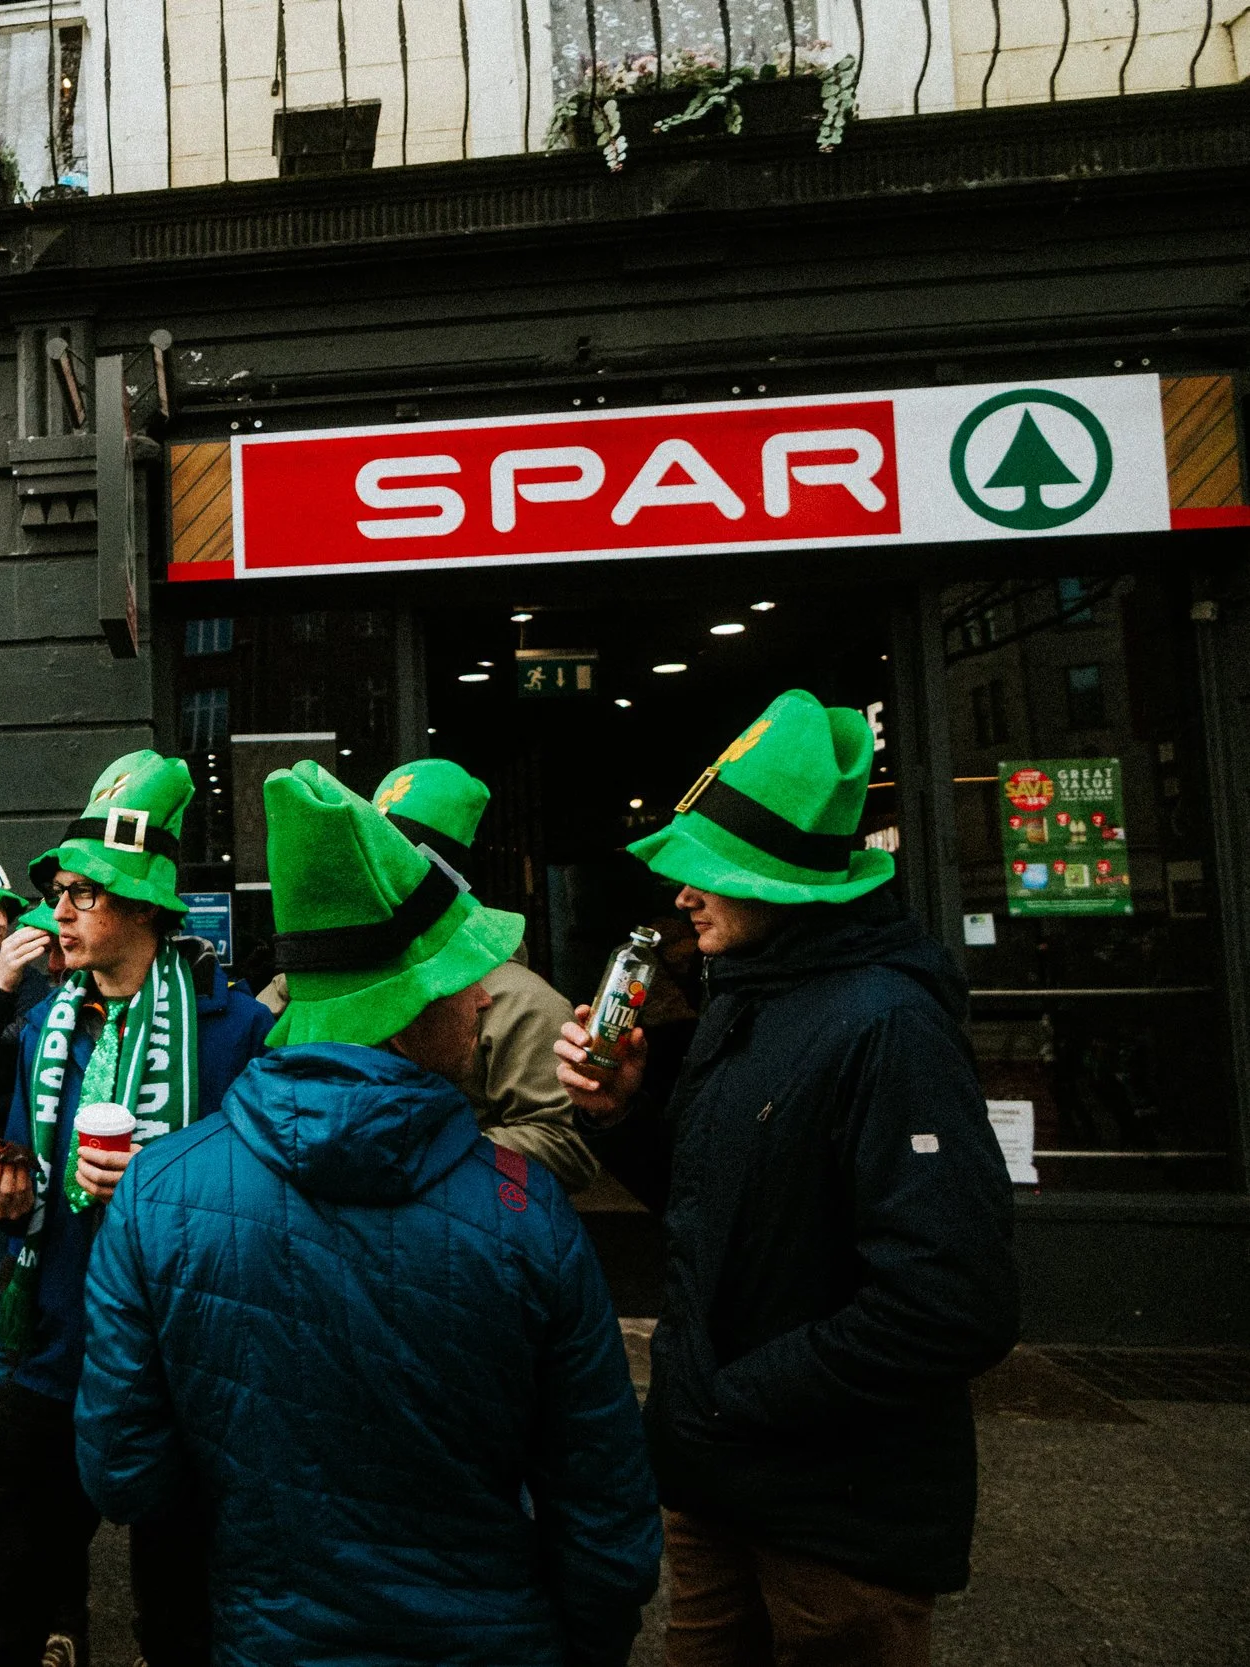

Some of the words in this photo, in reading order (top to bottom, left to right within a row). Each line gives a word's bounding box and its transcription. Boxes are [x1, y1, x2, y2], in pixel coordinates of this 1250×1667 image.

[355, 427, 887, 540] SPAR
[1057, 767, 1113, 779] GREAT
[1004, 780, 1054, 798] SAVE
[1059, 778, 1113, 789] VALUE
[36, 979, 86, 1123] HAPPY
